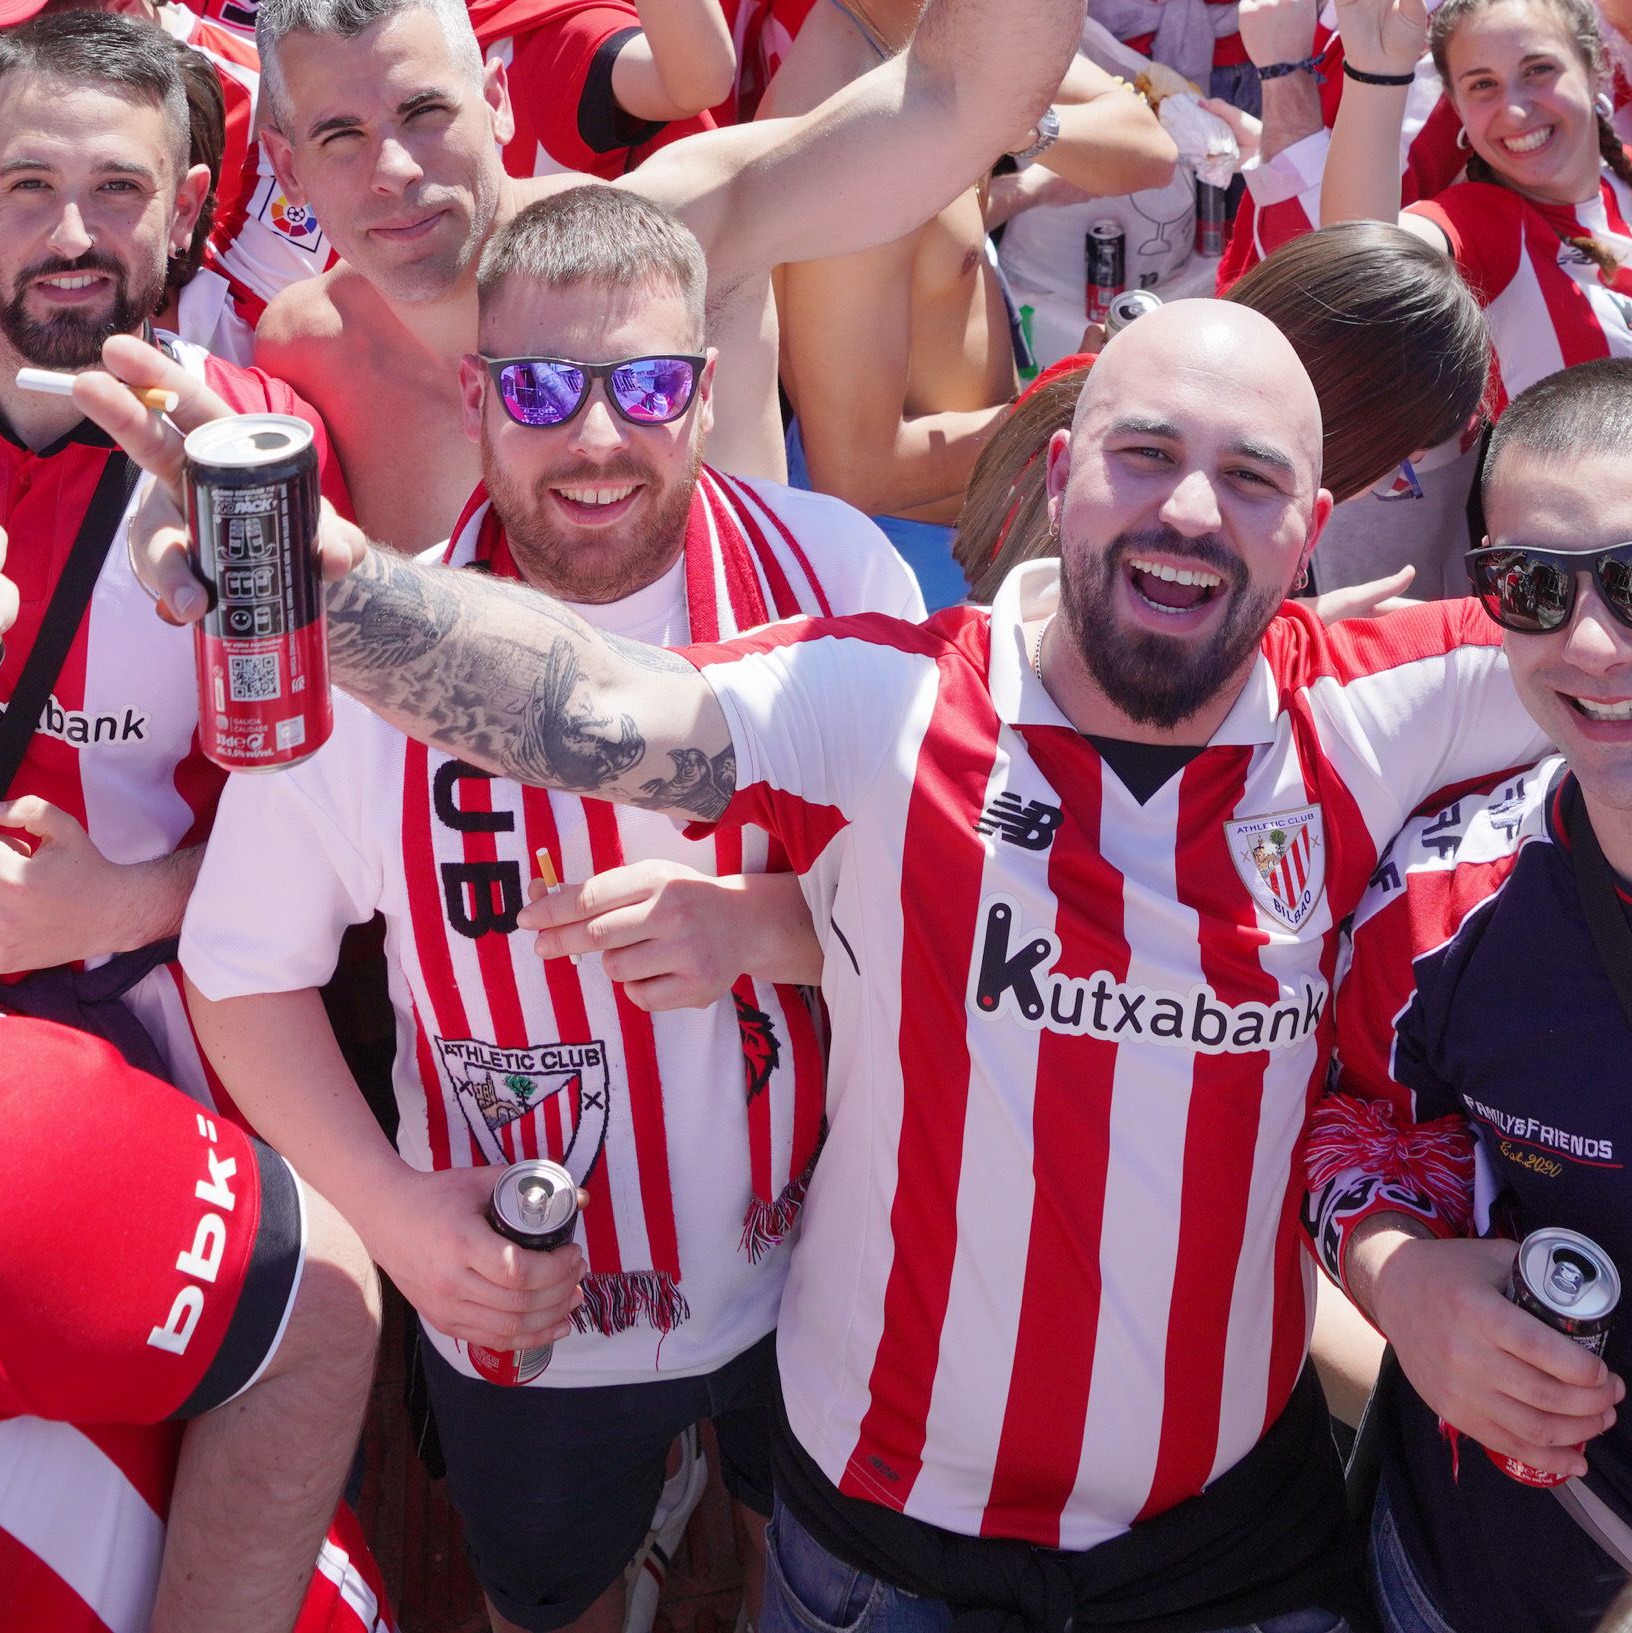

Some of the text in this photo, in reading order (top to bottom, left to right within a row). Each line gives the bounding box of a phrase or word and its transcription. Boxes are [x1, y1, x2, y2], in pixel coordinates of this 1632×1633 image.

[1235, 811, 1316, 836] ATHLETIC CLUB
[1270, 888, 1314, 929] BILBAO
[976, 902, 1325, 1053] Kutxabank
[443, 1041, 601, 1072] ATHLETIC CLUB
[1462, 1092, 1614, 1161] FAMILY&FRIENDS
